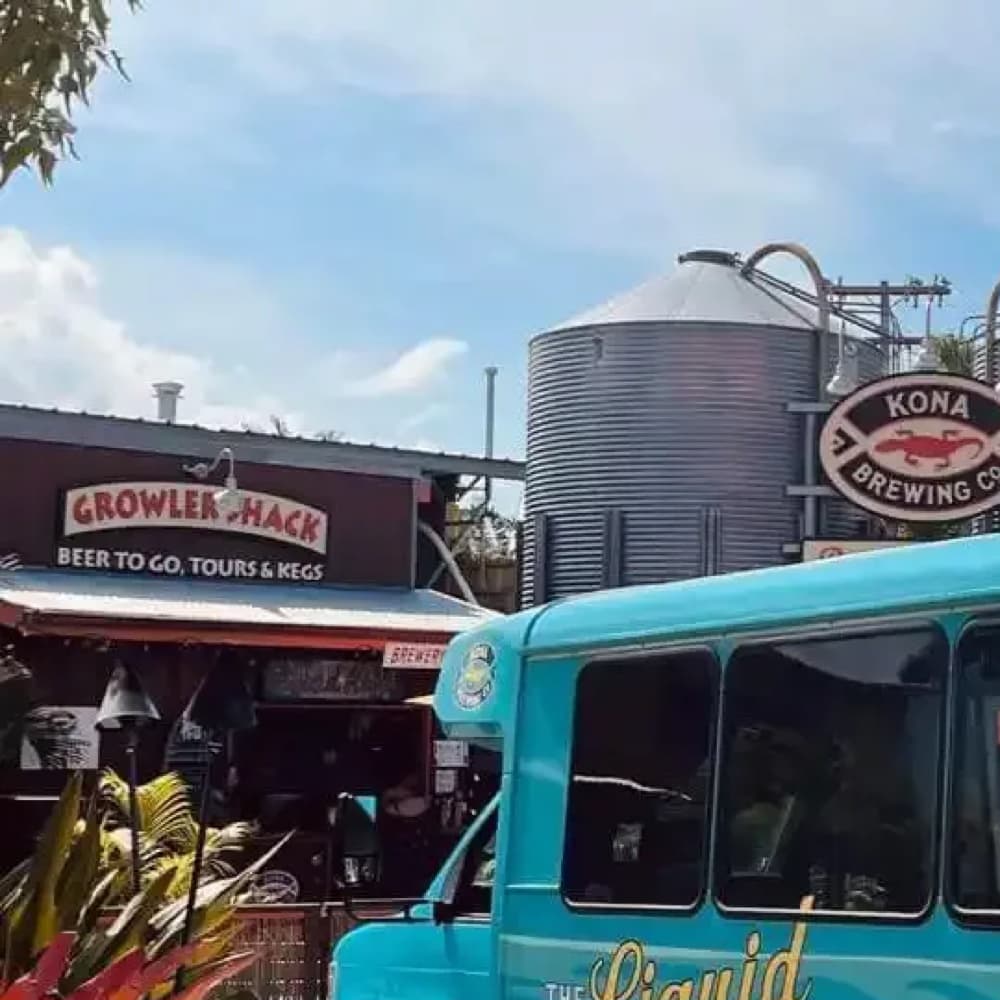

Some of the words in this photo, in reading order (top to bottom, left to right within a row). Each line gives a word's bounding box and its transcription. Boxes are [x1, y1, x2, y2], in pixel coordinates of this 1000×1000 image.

[885, 391, 970, 419] KONA
[853, 463, 971, 506] BREWING
[72, 488, 220, 525] GROWLER
[227, 498, 321, 543] HACK
[58, 547, 109, 568] BEER
[114, 552, 144, 570] TO
[150, 555, 185, 576] GO,
[188, 557, 256, 578] TOURS
[261, 560, 274, 579] &
[278, 562, 324, 581] KEGS
